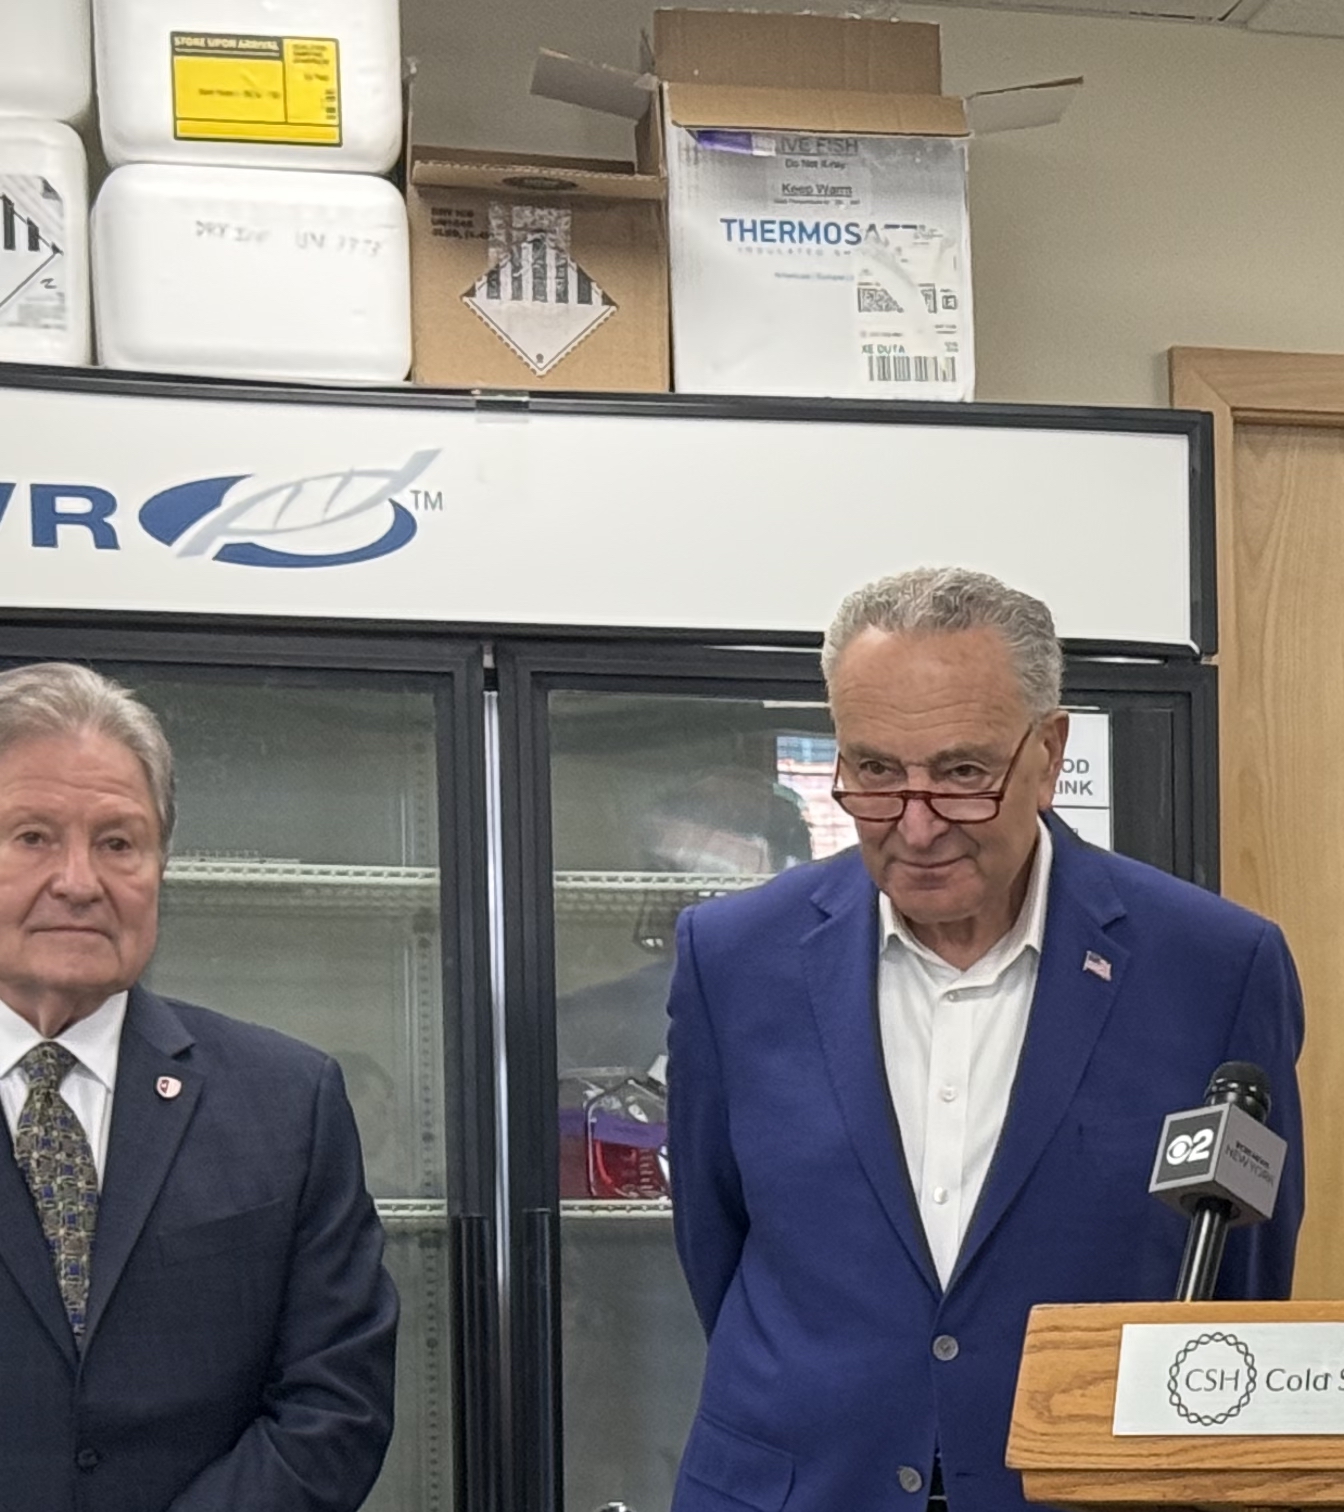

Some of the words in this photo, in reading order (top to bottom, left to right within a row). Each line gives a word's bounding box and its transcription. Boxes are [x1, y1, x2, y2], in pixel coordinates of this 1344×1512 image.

[173, 36, 206, 47] STORE
[206, 38, 237, 48] UPON
[781, 183, 814, 196] Keep
[409, 490, 443, 511] TM
[1185, 1368, 1241, 1392] CSH
[1265, 1367, 1332, 1392] Cold
